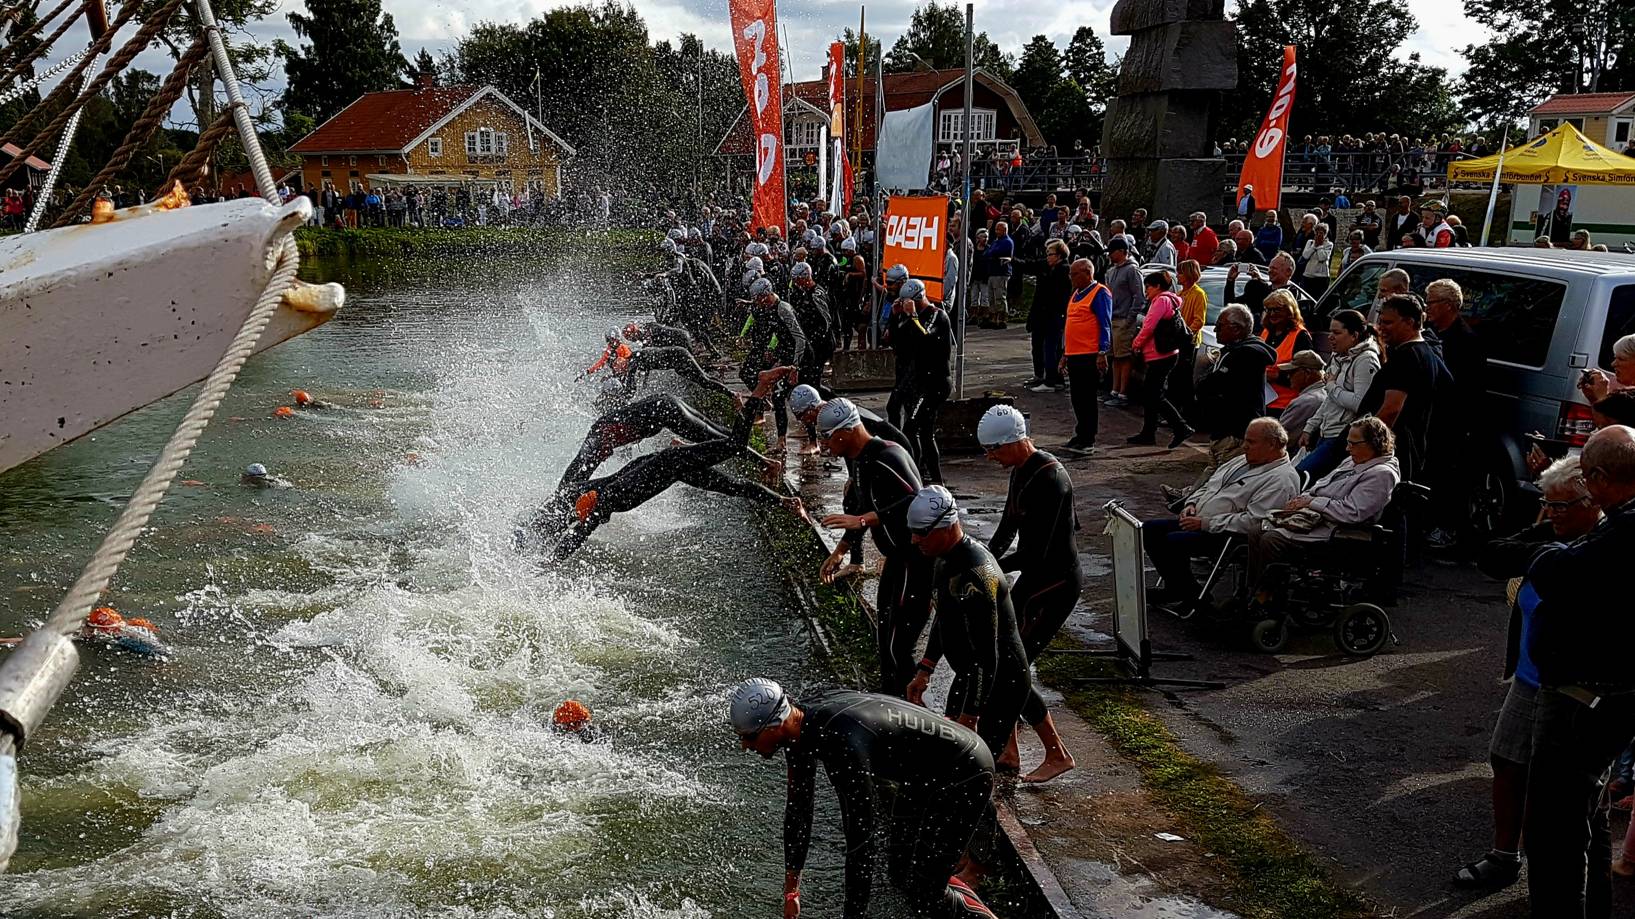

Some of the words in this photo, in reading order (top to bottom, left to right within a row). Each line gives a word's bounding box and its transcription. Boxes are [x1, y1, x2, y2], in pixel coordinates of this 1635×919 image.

[1460, 169, 1490, 179] Svenska
[1493, 171, 1542, 181] Smförbundet
[1572, 172, 1606, 182] Svenska
[1608, 172, 1635, 182] Simför
[887, 708, 956, 741] HUUB
